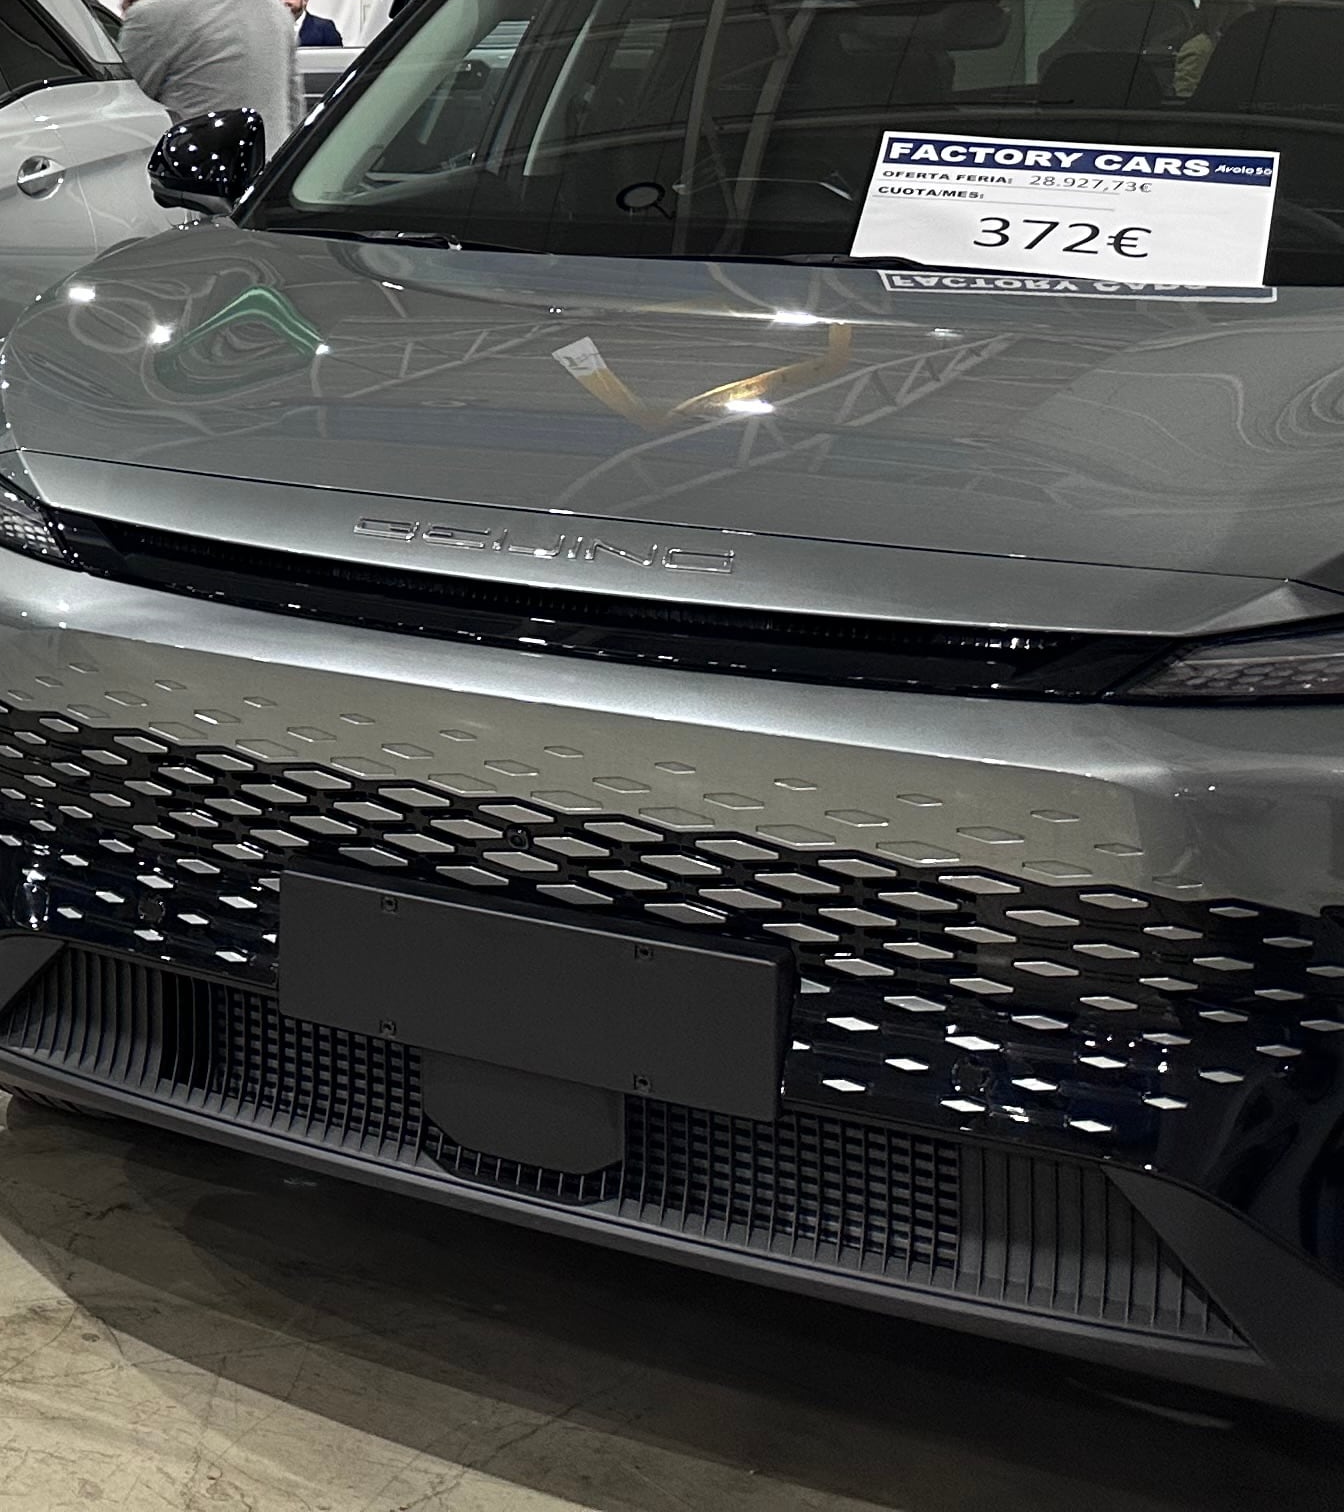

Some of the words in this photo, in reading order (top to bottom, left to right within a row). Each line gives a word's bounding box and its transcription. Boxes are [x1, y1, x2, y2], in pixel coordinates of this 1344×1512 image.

[888, 141, 1084, 171] FACTORY
[1094, 153, 1211, 177] CARS
[877, 185, 985, 200] CUOTA/MES:
[882, 170, 950, 183] OFERTA
[955, 173, 1014, 186] FERIA:
[1029, 175, 1153, 194] 28.927,73€
[972, 216, 1153, 259] 372€
[352, 516, 736, 575] BEIJING
